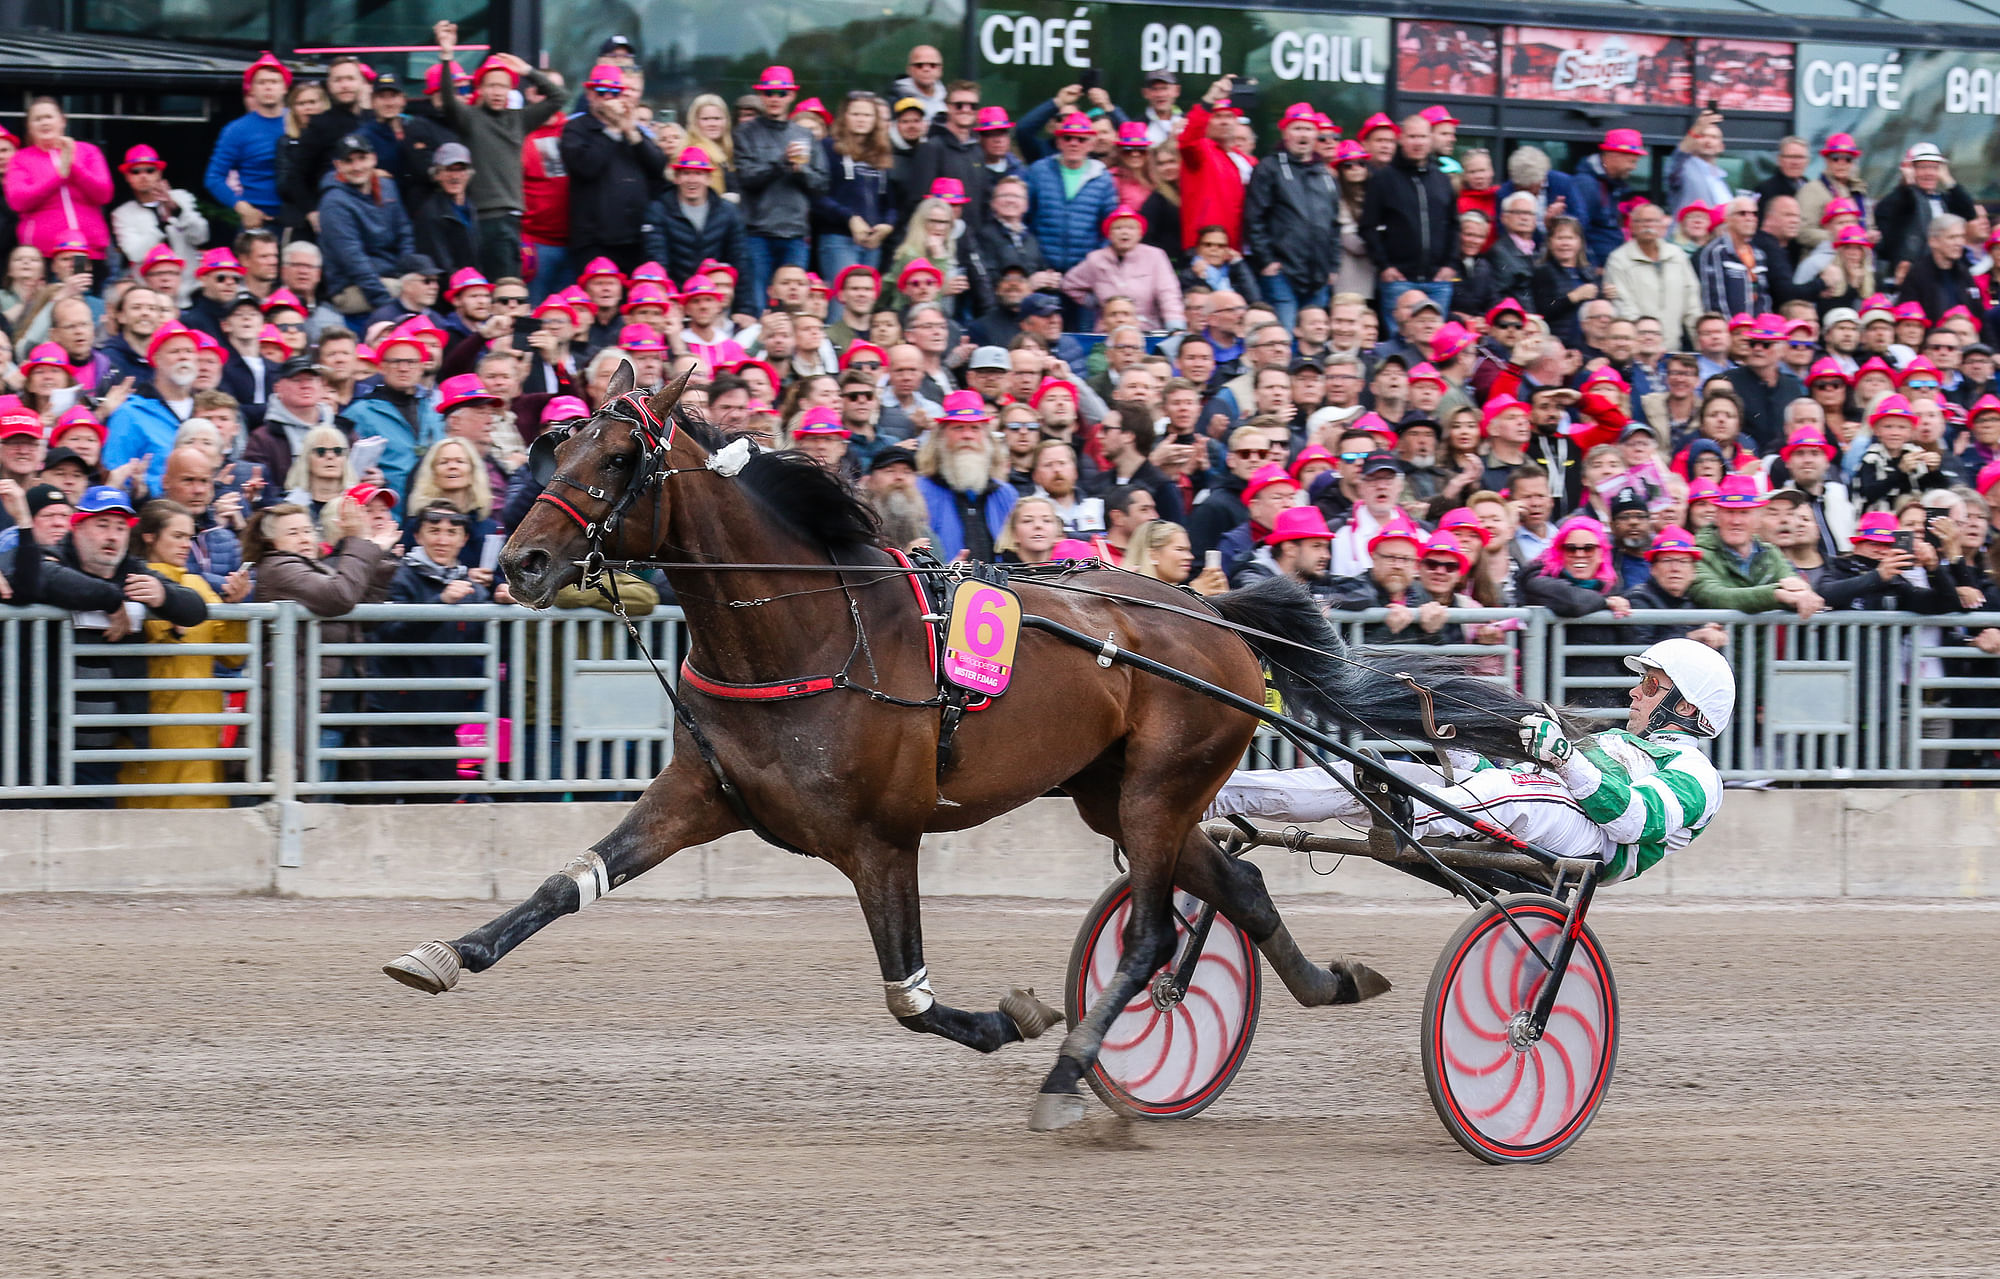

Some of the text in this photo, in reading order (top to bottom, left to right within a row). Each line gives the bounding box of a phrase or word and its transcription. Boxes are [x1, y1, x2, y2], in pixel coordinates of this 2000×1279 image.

[980, 7, 1385, 84] CAFÉ BAR GRILL
[1803, 53, 2000, 115] CAFÉ BA
[965, 588, 1007, 658] 6
